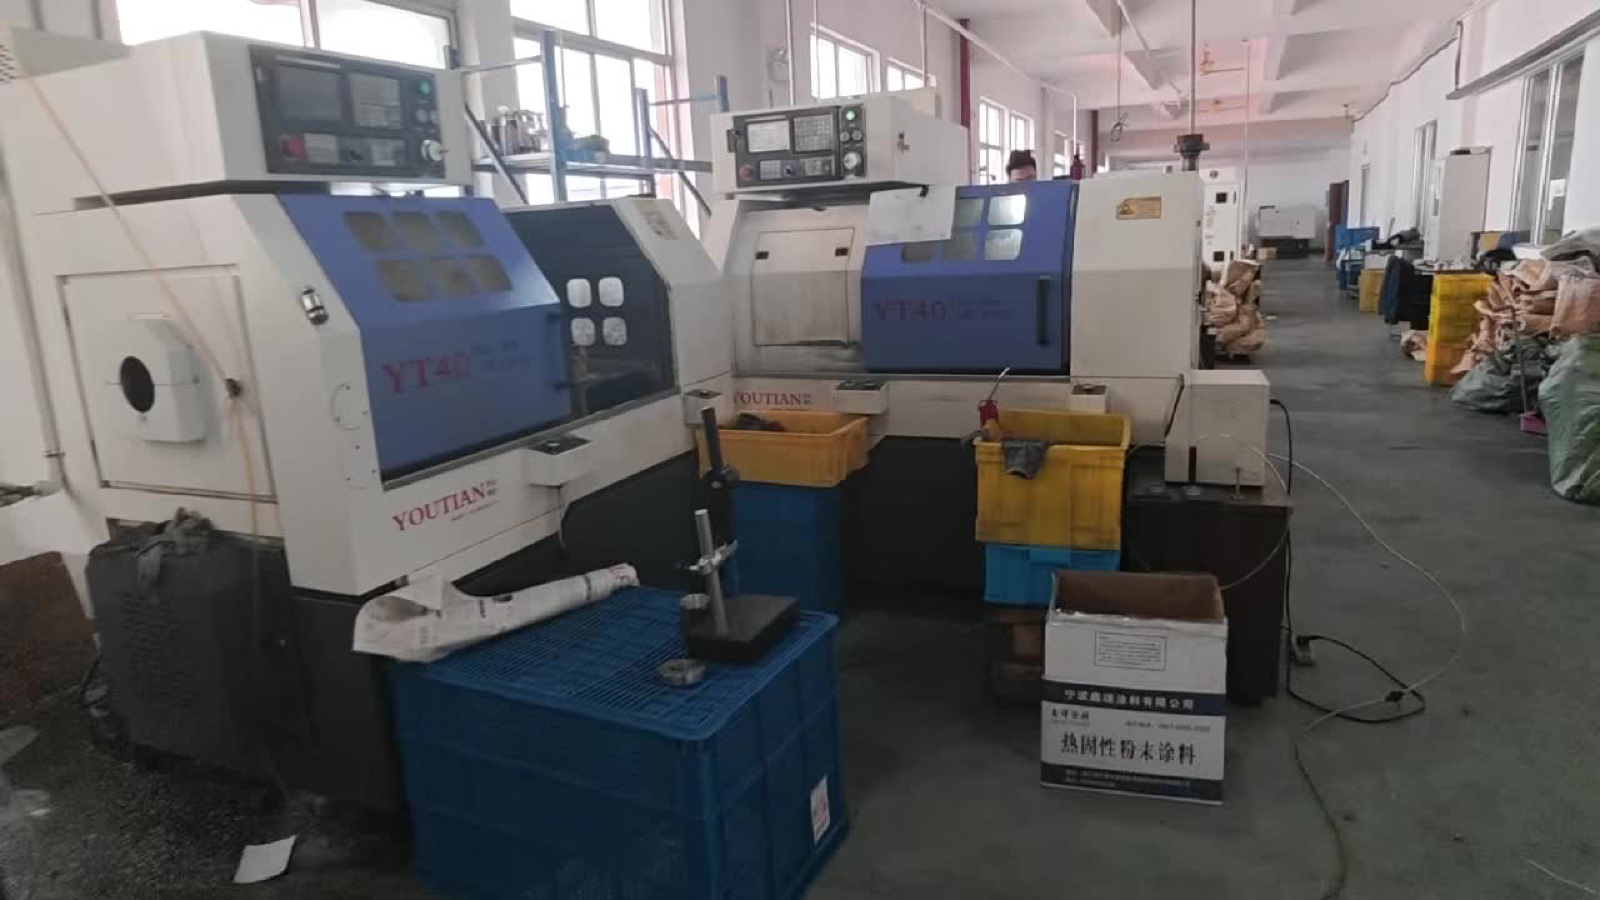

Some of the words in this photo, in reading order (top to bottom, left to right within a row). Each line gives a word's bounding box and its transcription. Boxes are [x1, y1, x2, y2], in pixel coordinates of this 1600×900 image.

[871, 299, 946, 321] YT40
[382, 350, 470, 394] YT40
[392, 482, 487, 531] YOUTIAN
[1060, 730, 1196, 766] 热固性粉末涂料
